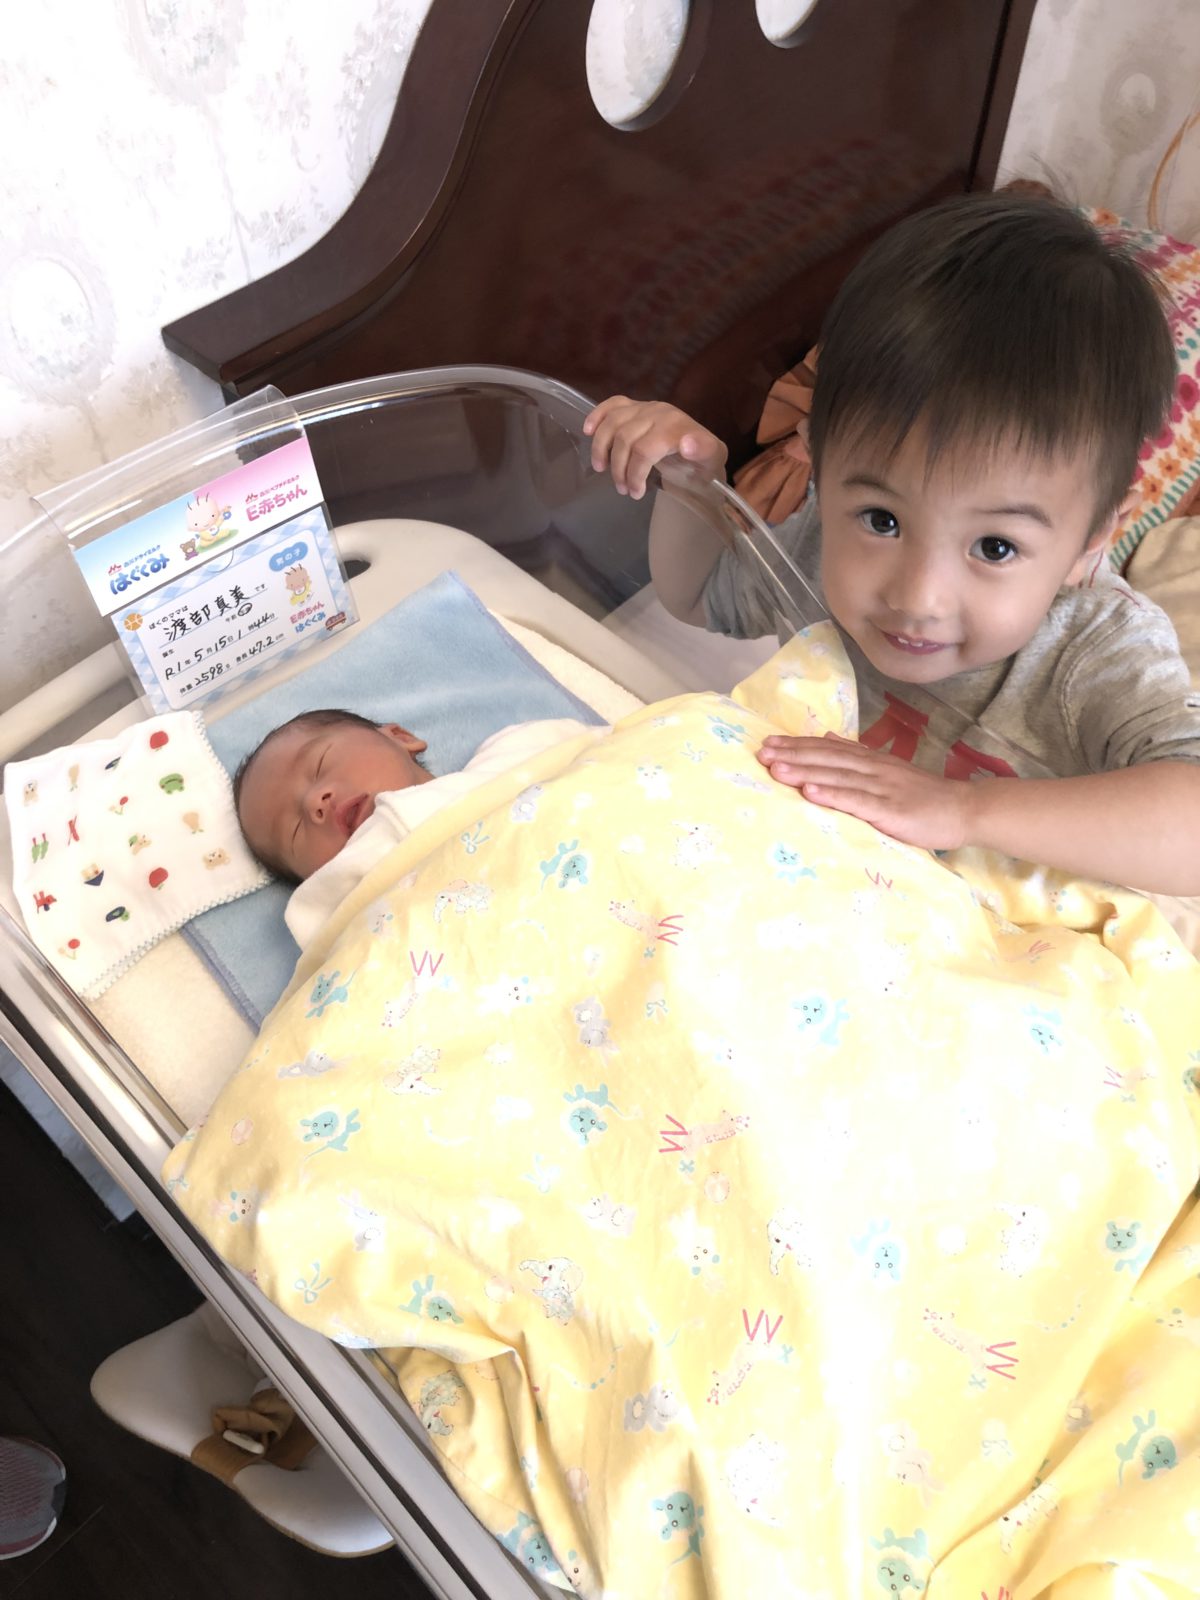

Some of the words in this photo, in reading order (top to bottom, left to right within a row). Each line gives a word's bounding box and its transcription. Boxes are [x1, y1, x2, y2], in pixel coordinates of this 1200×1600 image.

[246, 484, 308, 521] E赤ちゃん
[110, 553, 170, 595] はぐくみ
